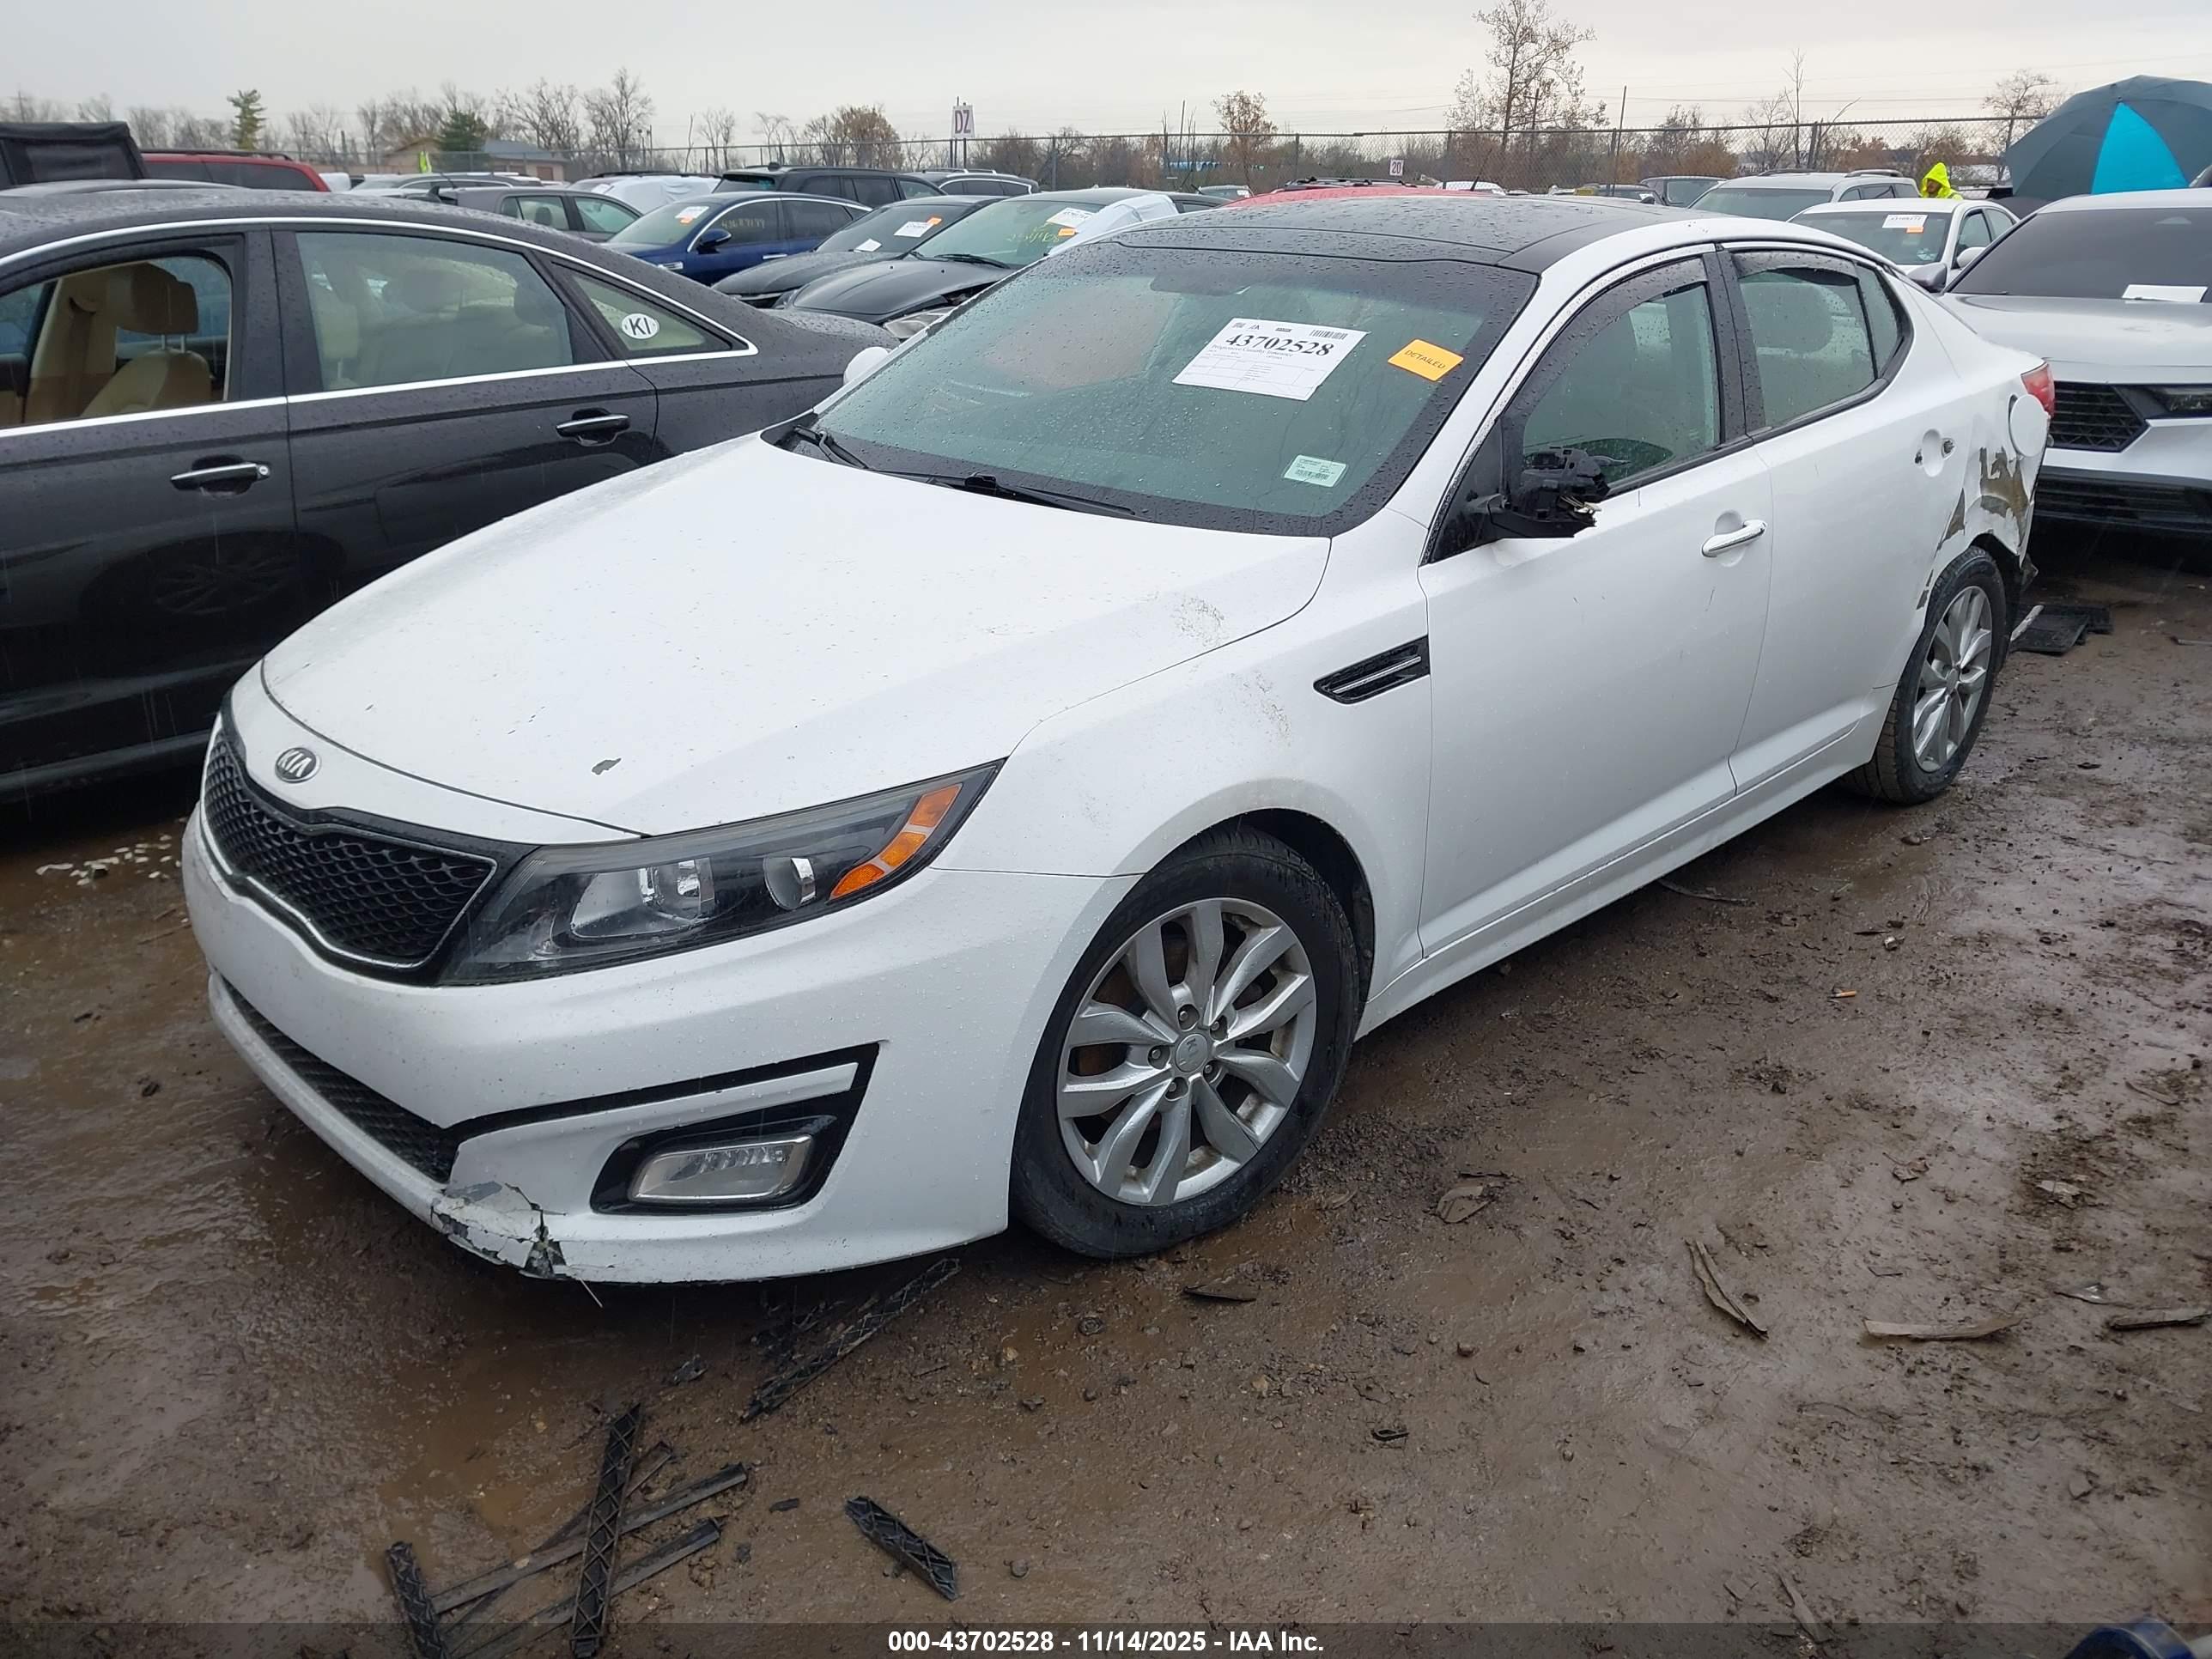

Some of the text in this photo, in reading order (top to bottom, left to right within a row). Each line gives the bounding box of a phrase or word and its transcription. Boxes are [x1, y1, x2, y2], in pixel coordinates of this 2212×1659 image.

[629, 317, 651, 336] KI
[1225, 333, 1334, 356] 43702528
[1404, 349, 1446, 369] DETAILED
[277, 750, 312, 778] KIA
